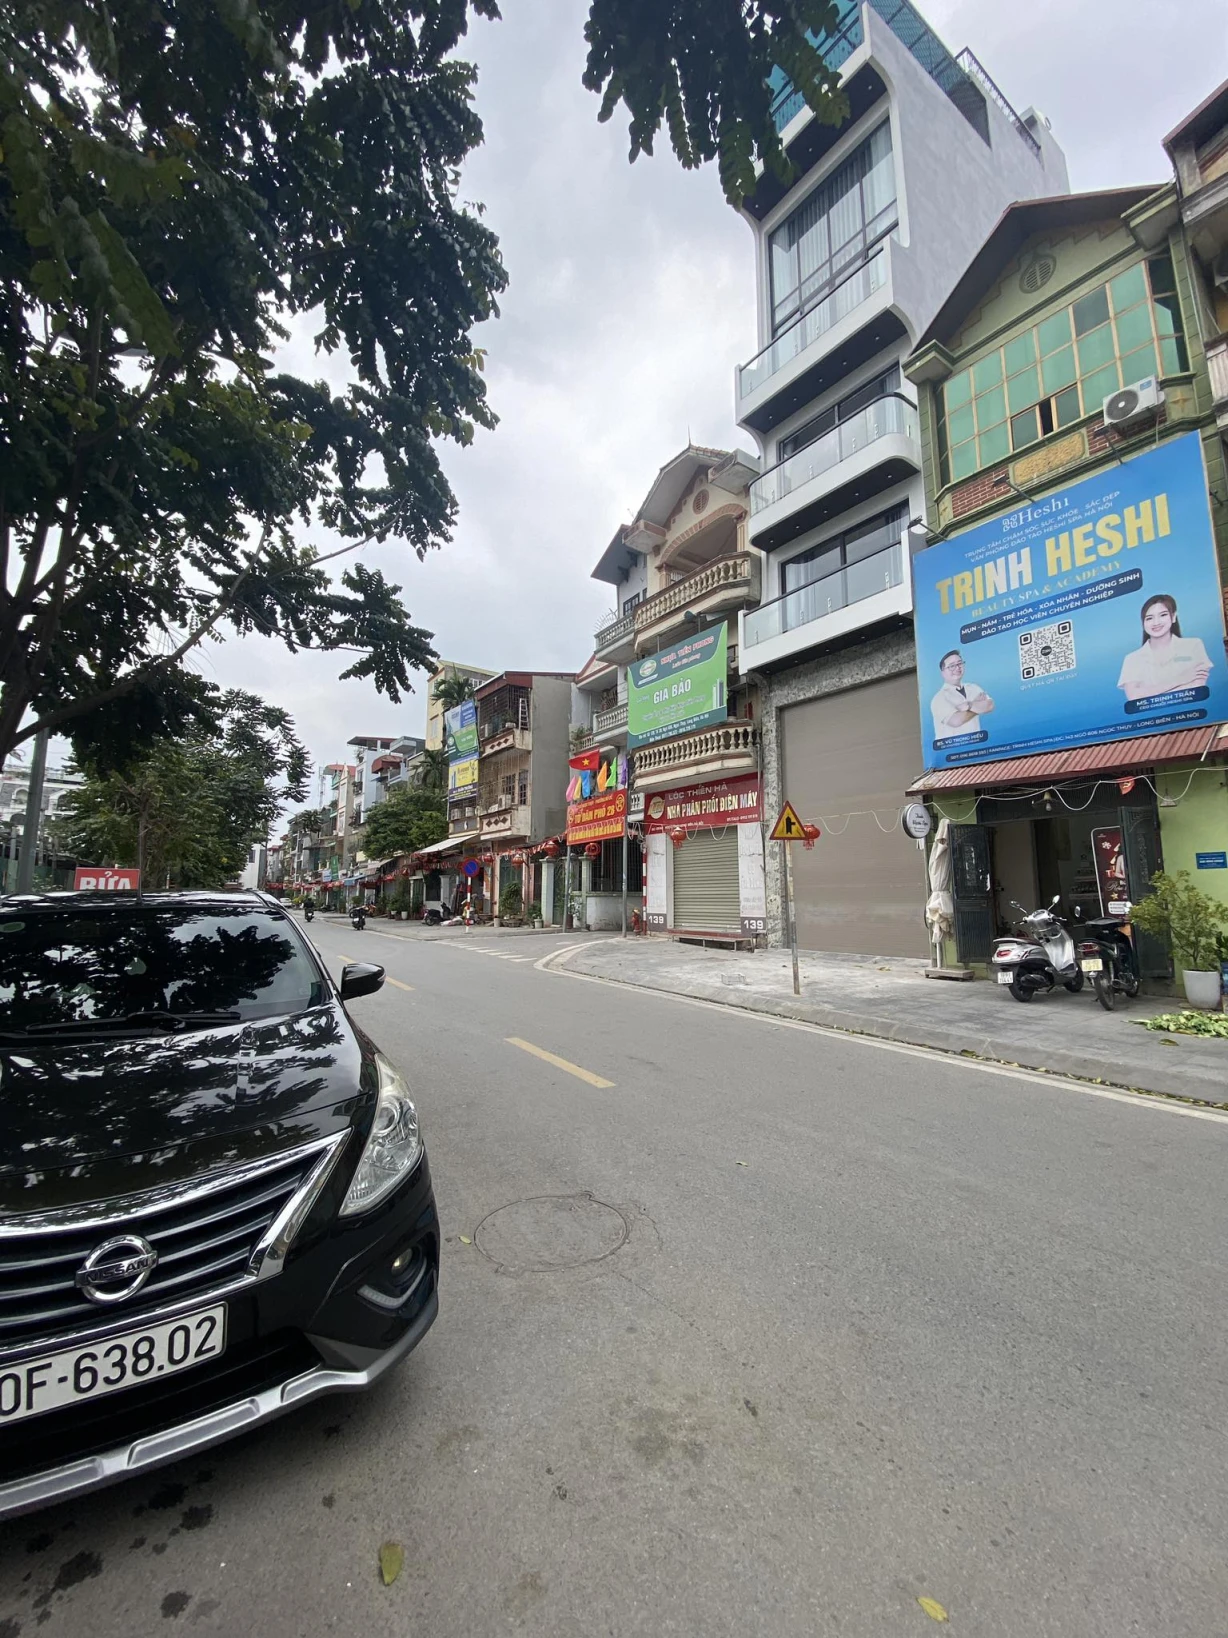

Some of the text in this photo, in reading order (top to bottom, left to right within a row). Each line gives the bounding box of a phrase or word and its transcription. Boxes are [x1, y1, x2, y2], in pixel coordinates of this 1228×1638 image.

[1016, 497, 1070, 525] Heshi
[1043, 520, 1067, 534] HESHI
[1067, 513, 1083, 525] SPA
[1084, 506, 1097, 518] HÀ
[1045, 493, 1171, 577] HESHI
[964, 546, 988, 558] TRUNG
[971, 561, 1122, 618] BEAUTY SPA & ACADEMY
[1086, 580, 1118, 595] DƯỠNG
[1118, 572, 1141, 585] SINH
[981, 626, 997, 637] ĐÀO
[1030, 609, 1049, 621] VIÊN
[1048, 600, 1082, 616] CHUYÊN
[1082, 590, 1115, 605] NGHIỆP
[653, 688, 669, 704] GIA
[671, 677, 692, 697] BẢO
[1136, 720, 1155, 728] LONG
[714, 782, 728, 793] HÀ
[682, 799, 701, 817] PHÂN
[702, 794, 719, 815] PHỐI
[720, 793, 739, 813] ĐIỆN
[739, 790, 758, 809] MÁY
[648, 915, 664, 924] 139
[743, 919, 764, 930] 139
[86, 1258, 149, 1283] NISSAN
